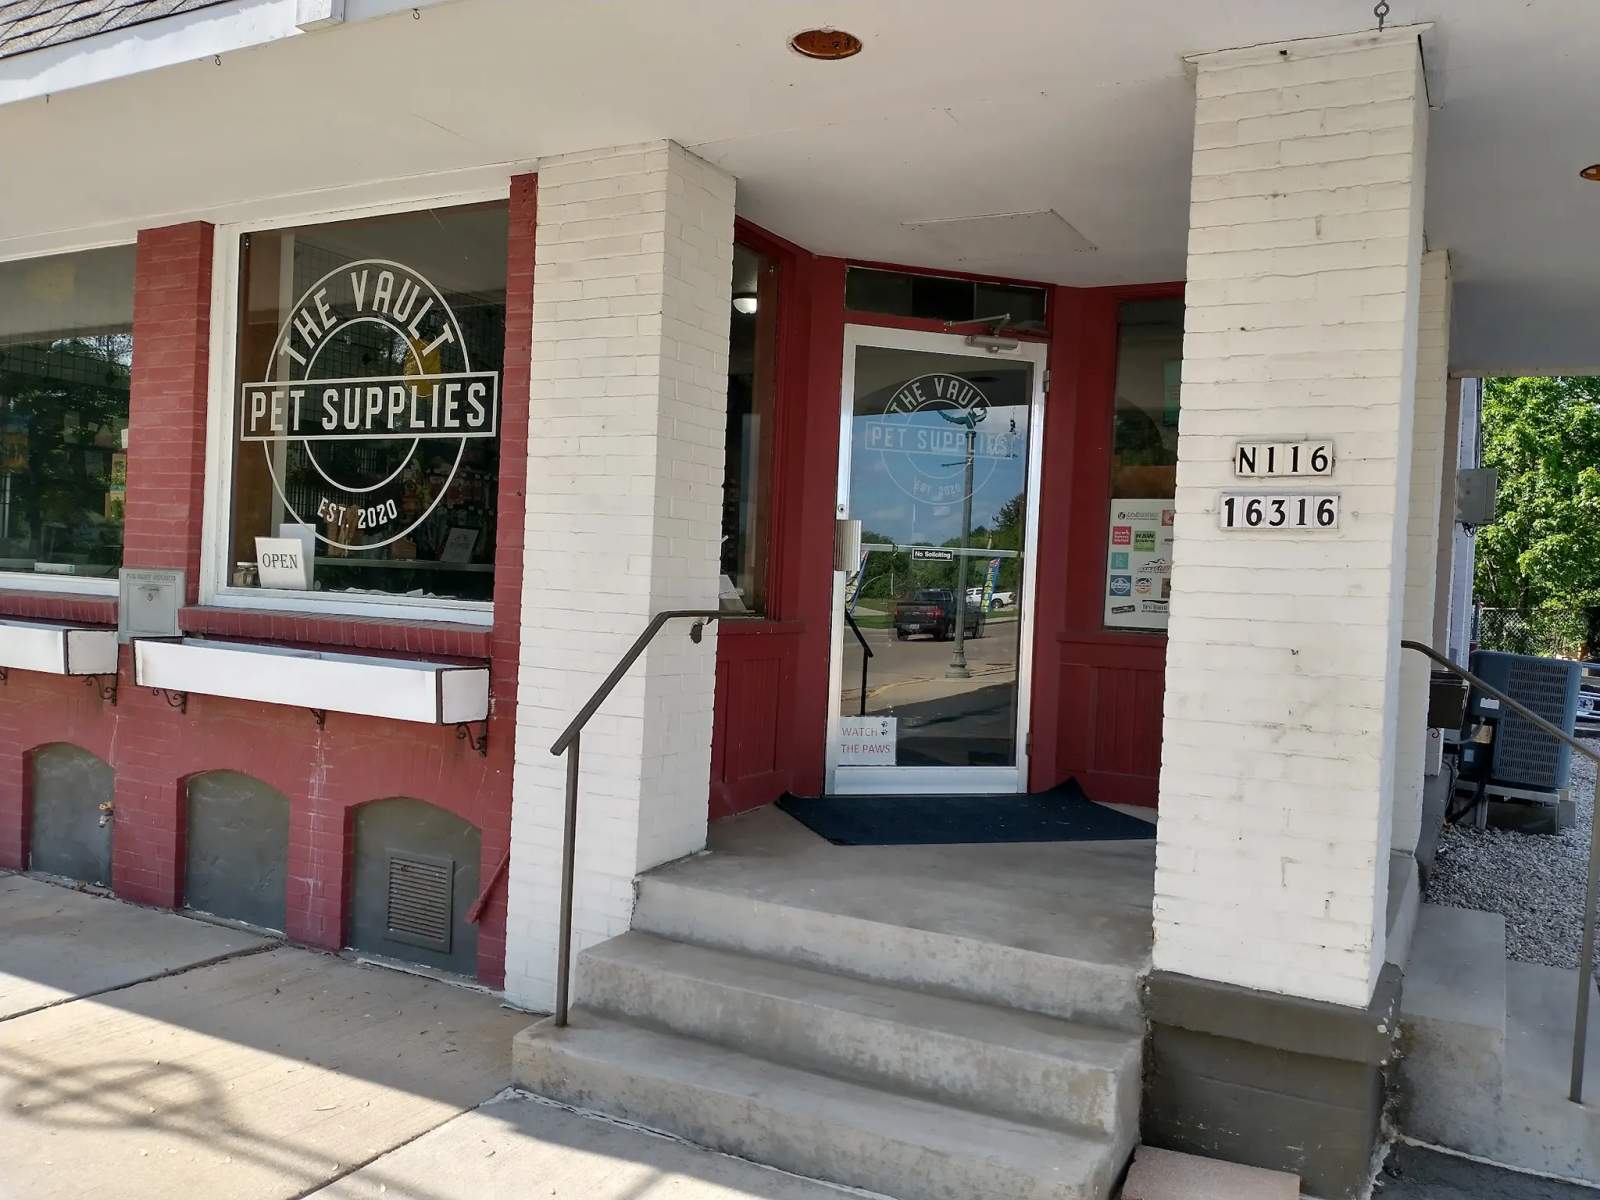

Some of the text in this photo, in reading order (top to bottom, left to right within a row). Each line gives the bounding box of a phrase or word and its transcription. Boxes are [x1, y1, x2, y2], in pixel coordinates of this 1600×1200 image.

[280, 270, 455, 366] THE VAULT
[250, 381, 486, 432] PET SUPPLIES
[890, 382, 926, 416] THE
[871, 426, 907, 447] PET
[1239, 444, 1328, 473] N116
[317, 496, 398, 529] EST. 2020
[1224, 497, 1335, 527] 16316
[262, 552, 298, 570] OPEN
[925, 551, 951, 559] Soliciting
[842, 727, 878, 737] WATCH
[841, 744, 891, 753] THE PAWS
